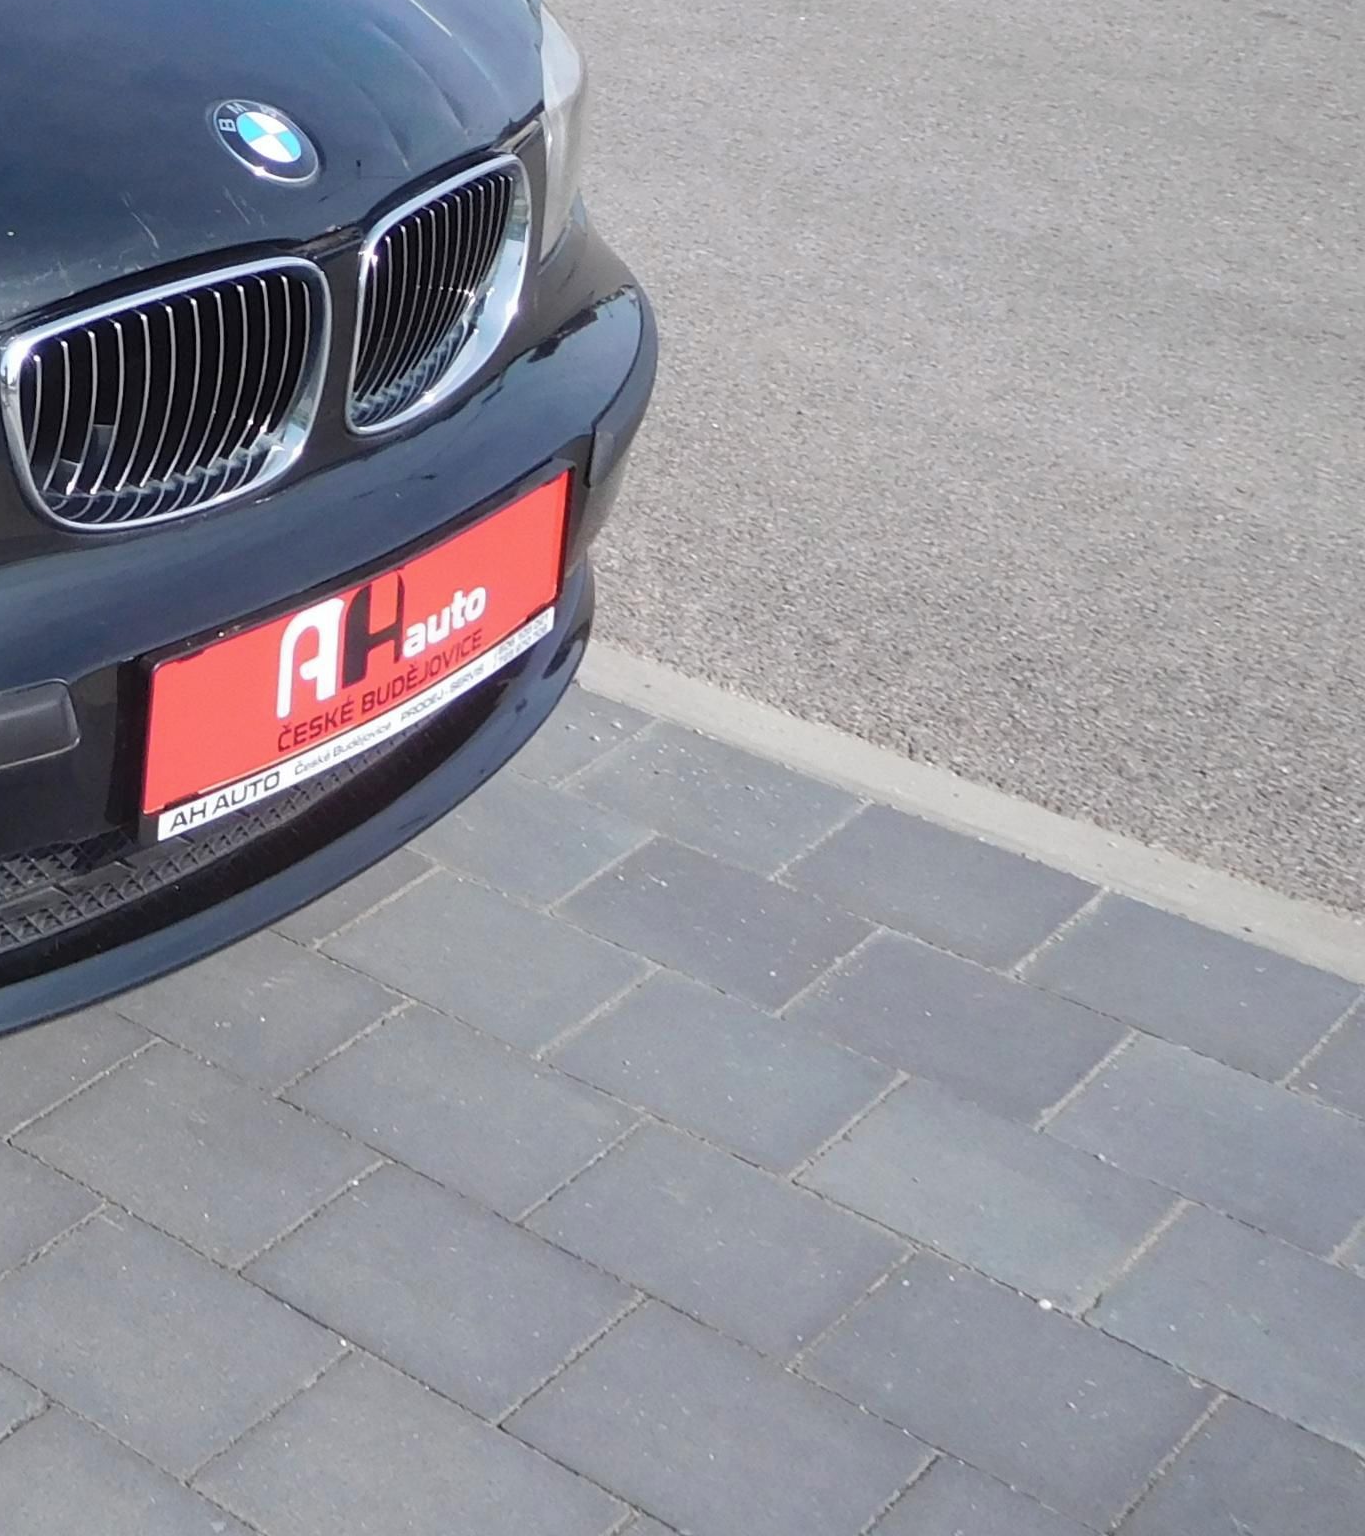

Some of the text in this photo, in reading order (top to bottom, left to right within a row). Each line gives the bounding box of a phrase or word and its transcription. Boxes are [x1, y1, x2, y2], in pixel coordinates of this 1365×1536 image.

[278, 695, 354, 752] ČESKÉ
[361, 629, 482, 714] BUDĚJOVICE
[170, 803, 207, 832] AH
[213, 771, 280, 815] AUTO
